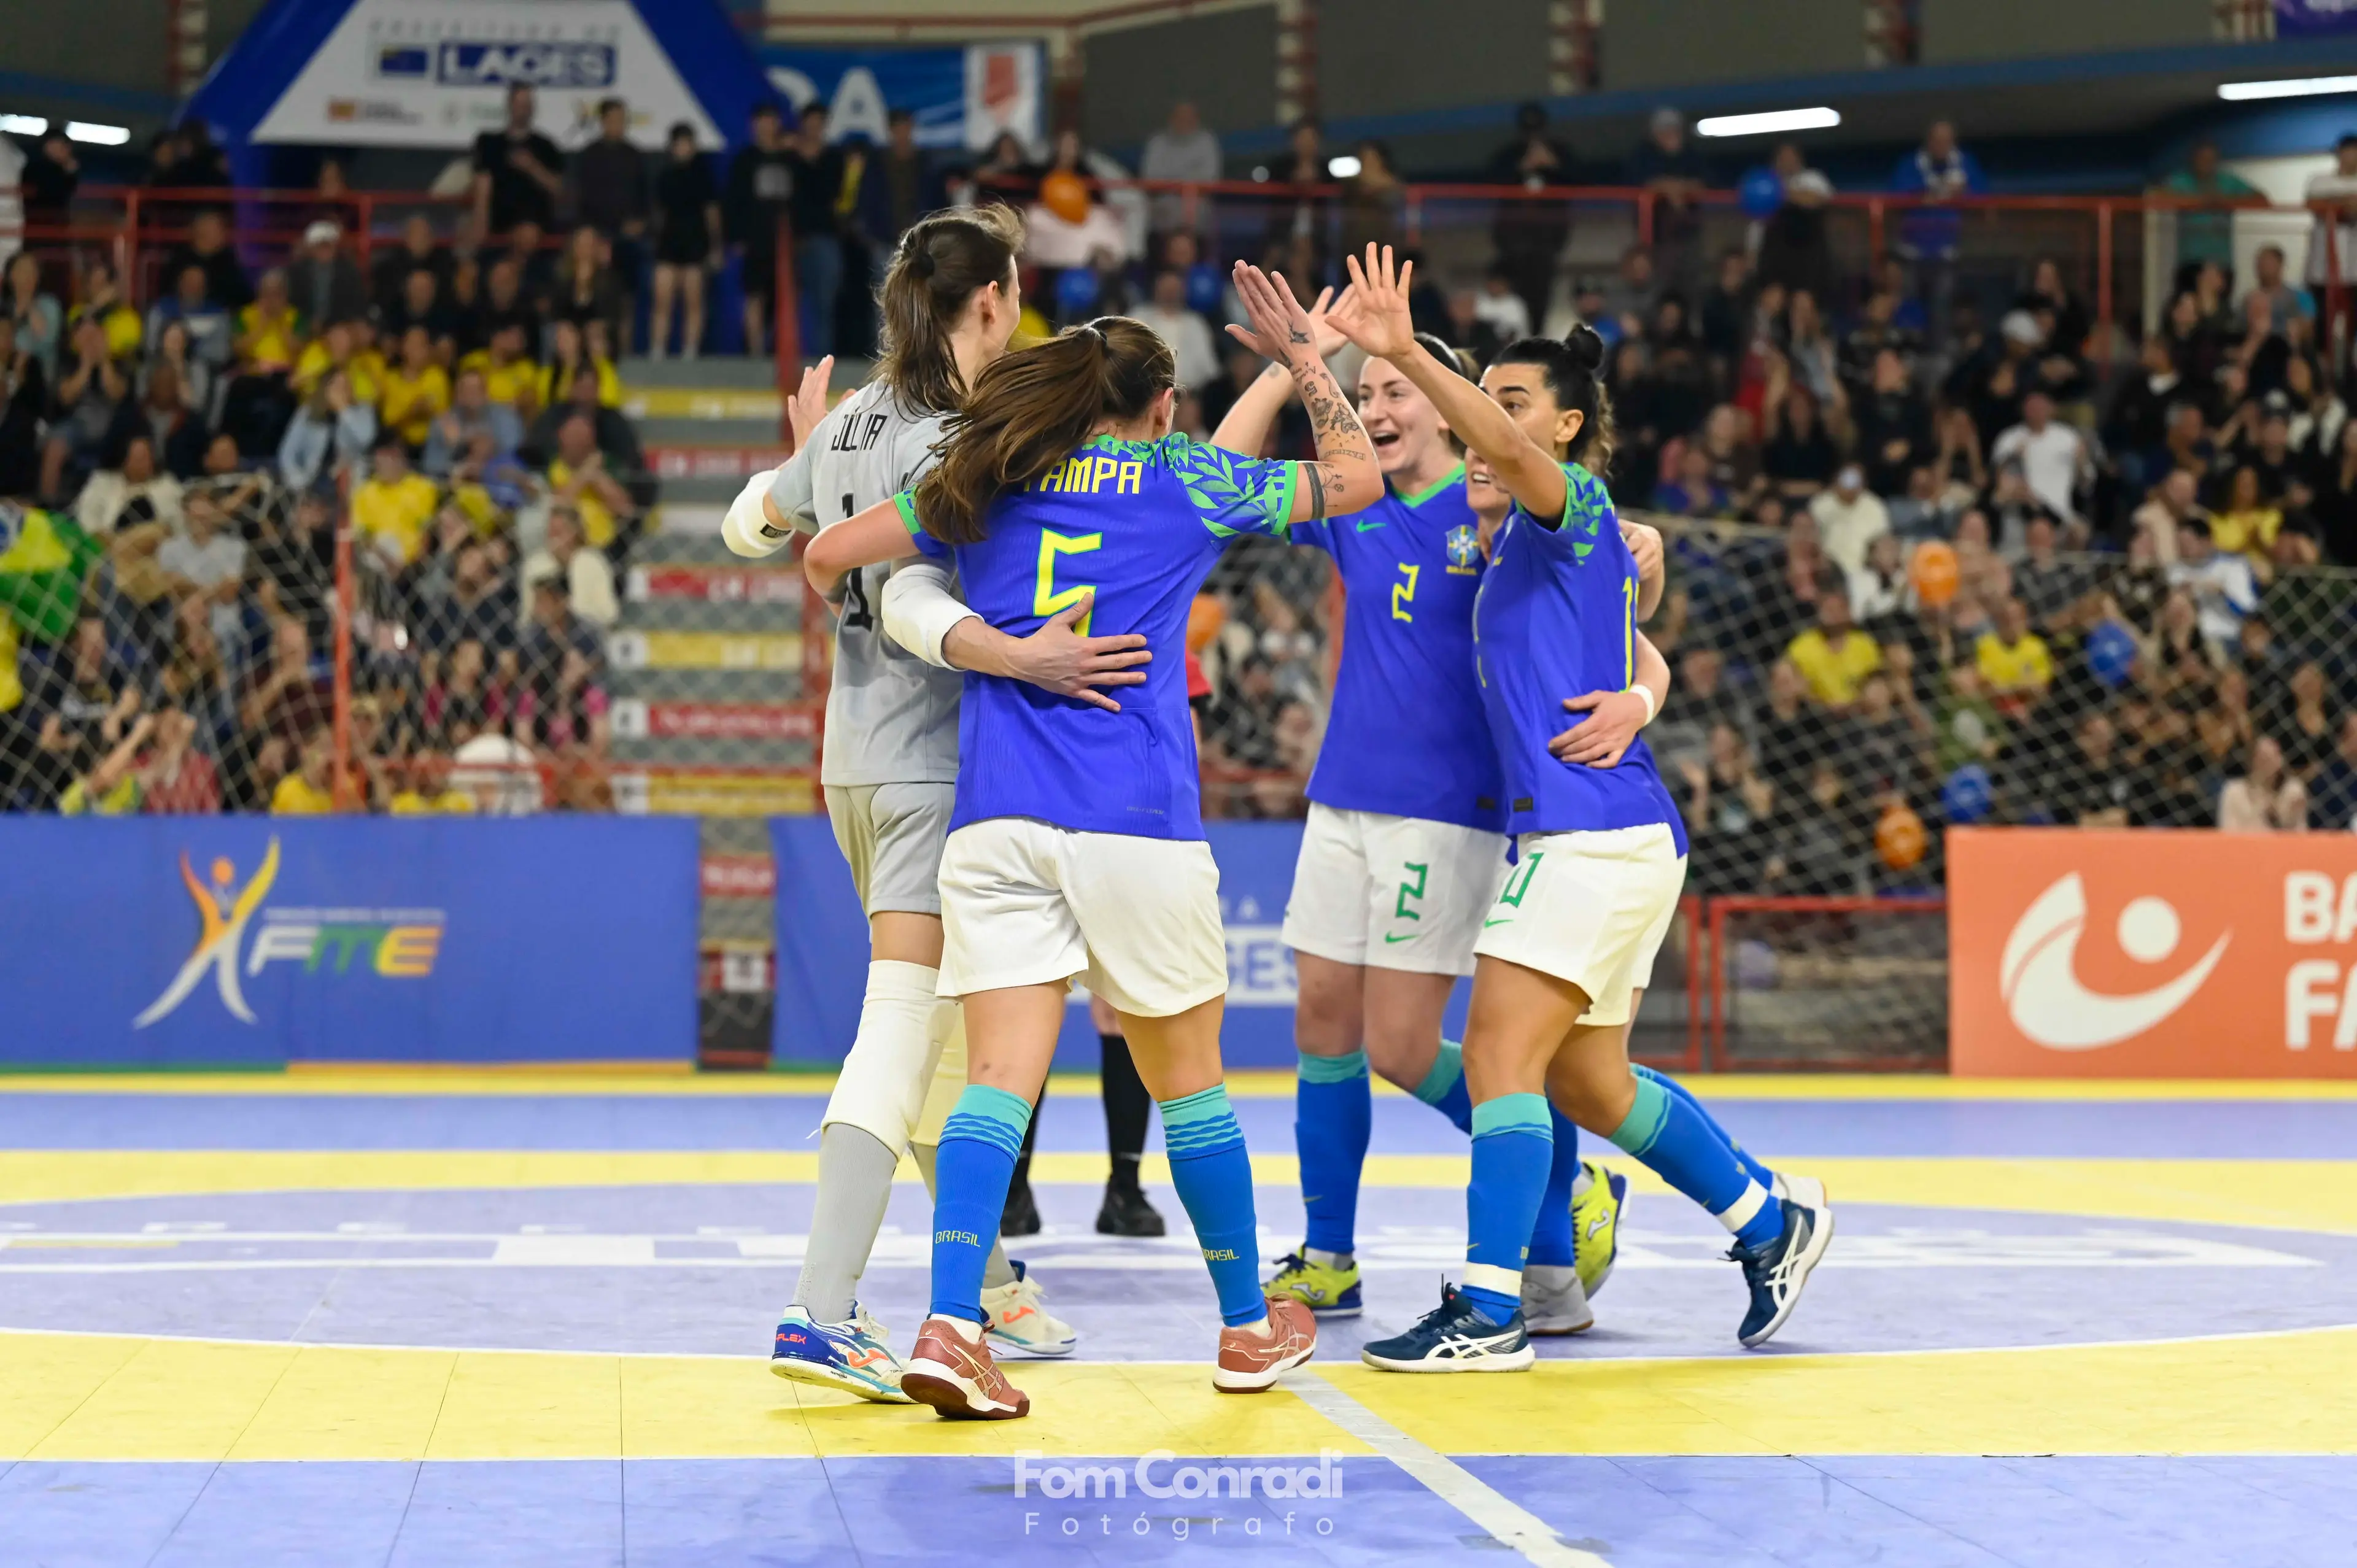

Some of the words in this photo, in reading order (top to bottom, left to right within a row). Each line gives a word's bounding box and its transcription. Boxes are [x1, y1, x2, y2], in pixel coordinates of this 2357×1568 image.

[1023, 456, 1143, 495] AMPA
[1033, 527, 1103, 638] 5
[1391, 562, 1420, 622] 2
[1396, 862, 1428, 921] 2
[1493, 851, 1544, 909] 0
[935, 1230, 981, 1247] BRASIL
